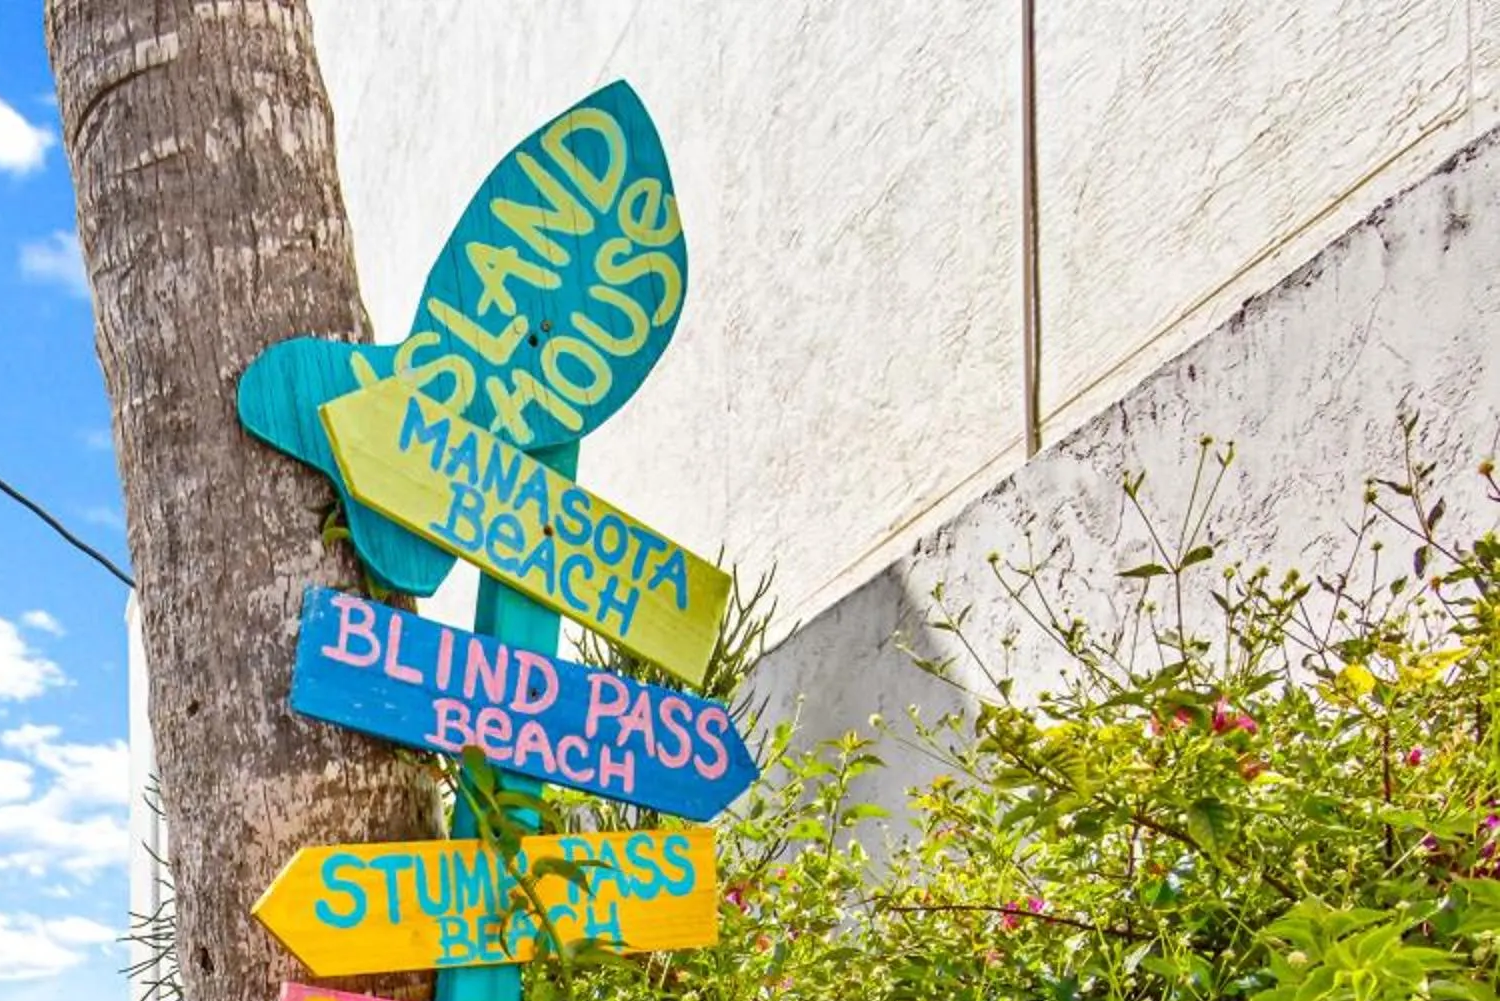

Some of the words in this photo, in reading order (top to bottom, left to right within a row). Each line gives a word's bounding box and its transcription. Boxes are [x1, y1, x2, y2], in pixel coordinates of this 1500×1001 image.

[399, 396, 688, 611] MANASOTA
[322, 597, 559, 714] BLIND
[587, 673, 728, 780] PASS
[558, 832, 696, 905] PASS
